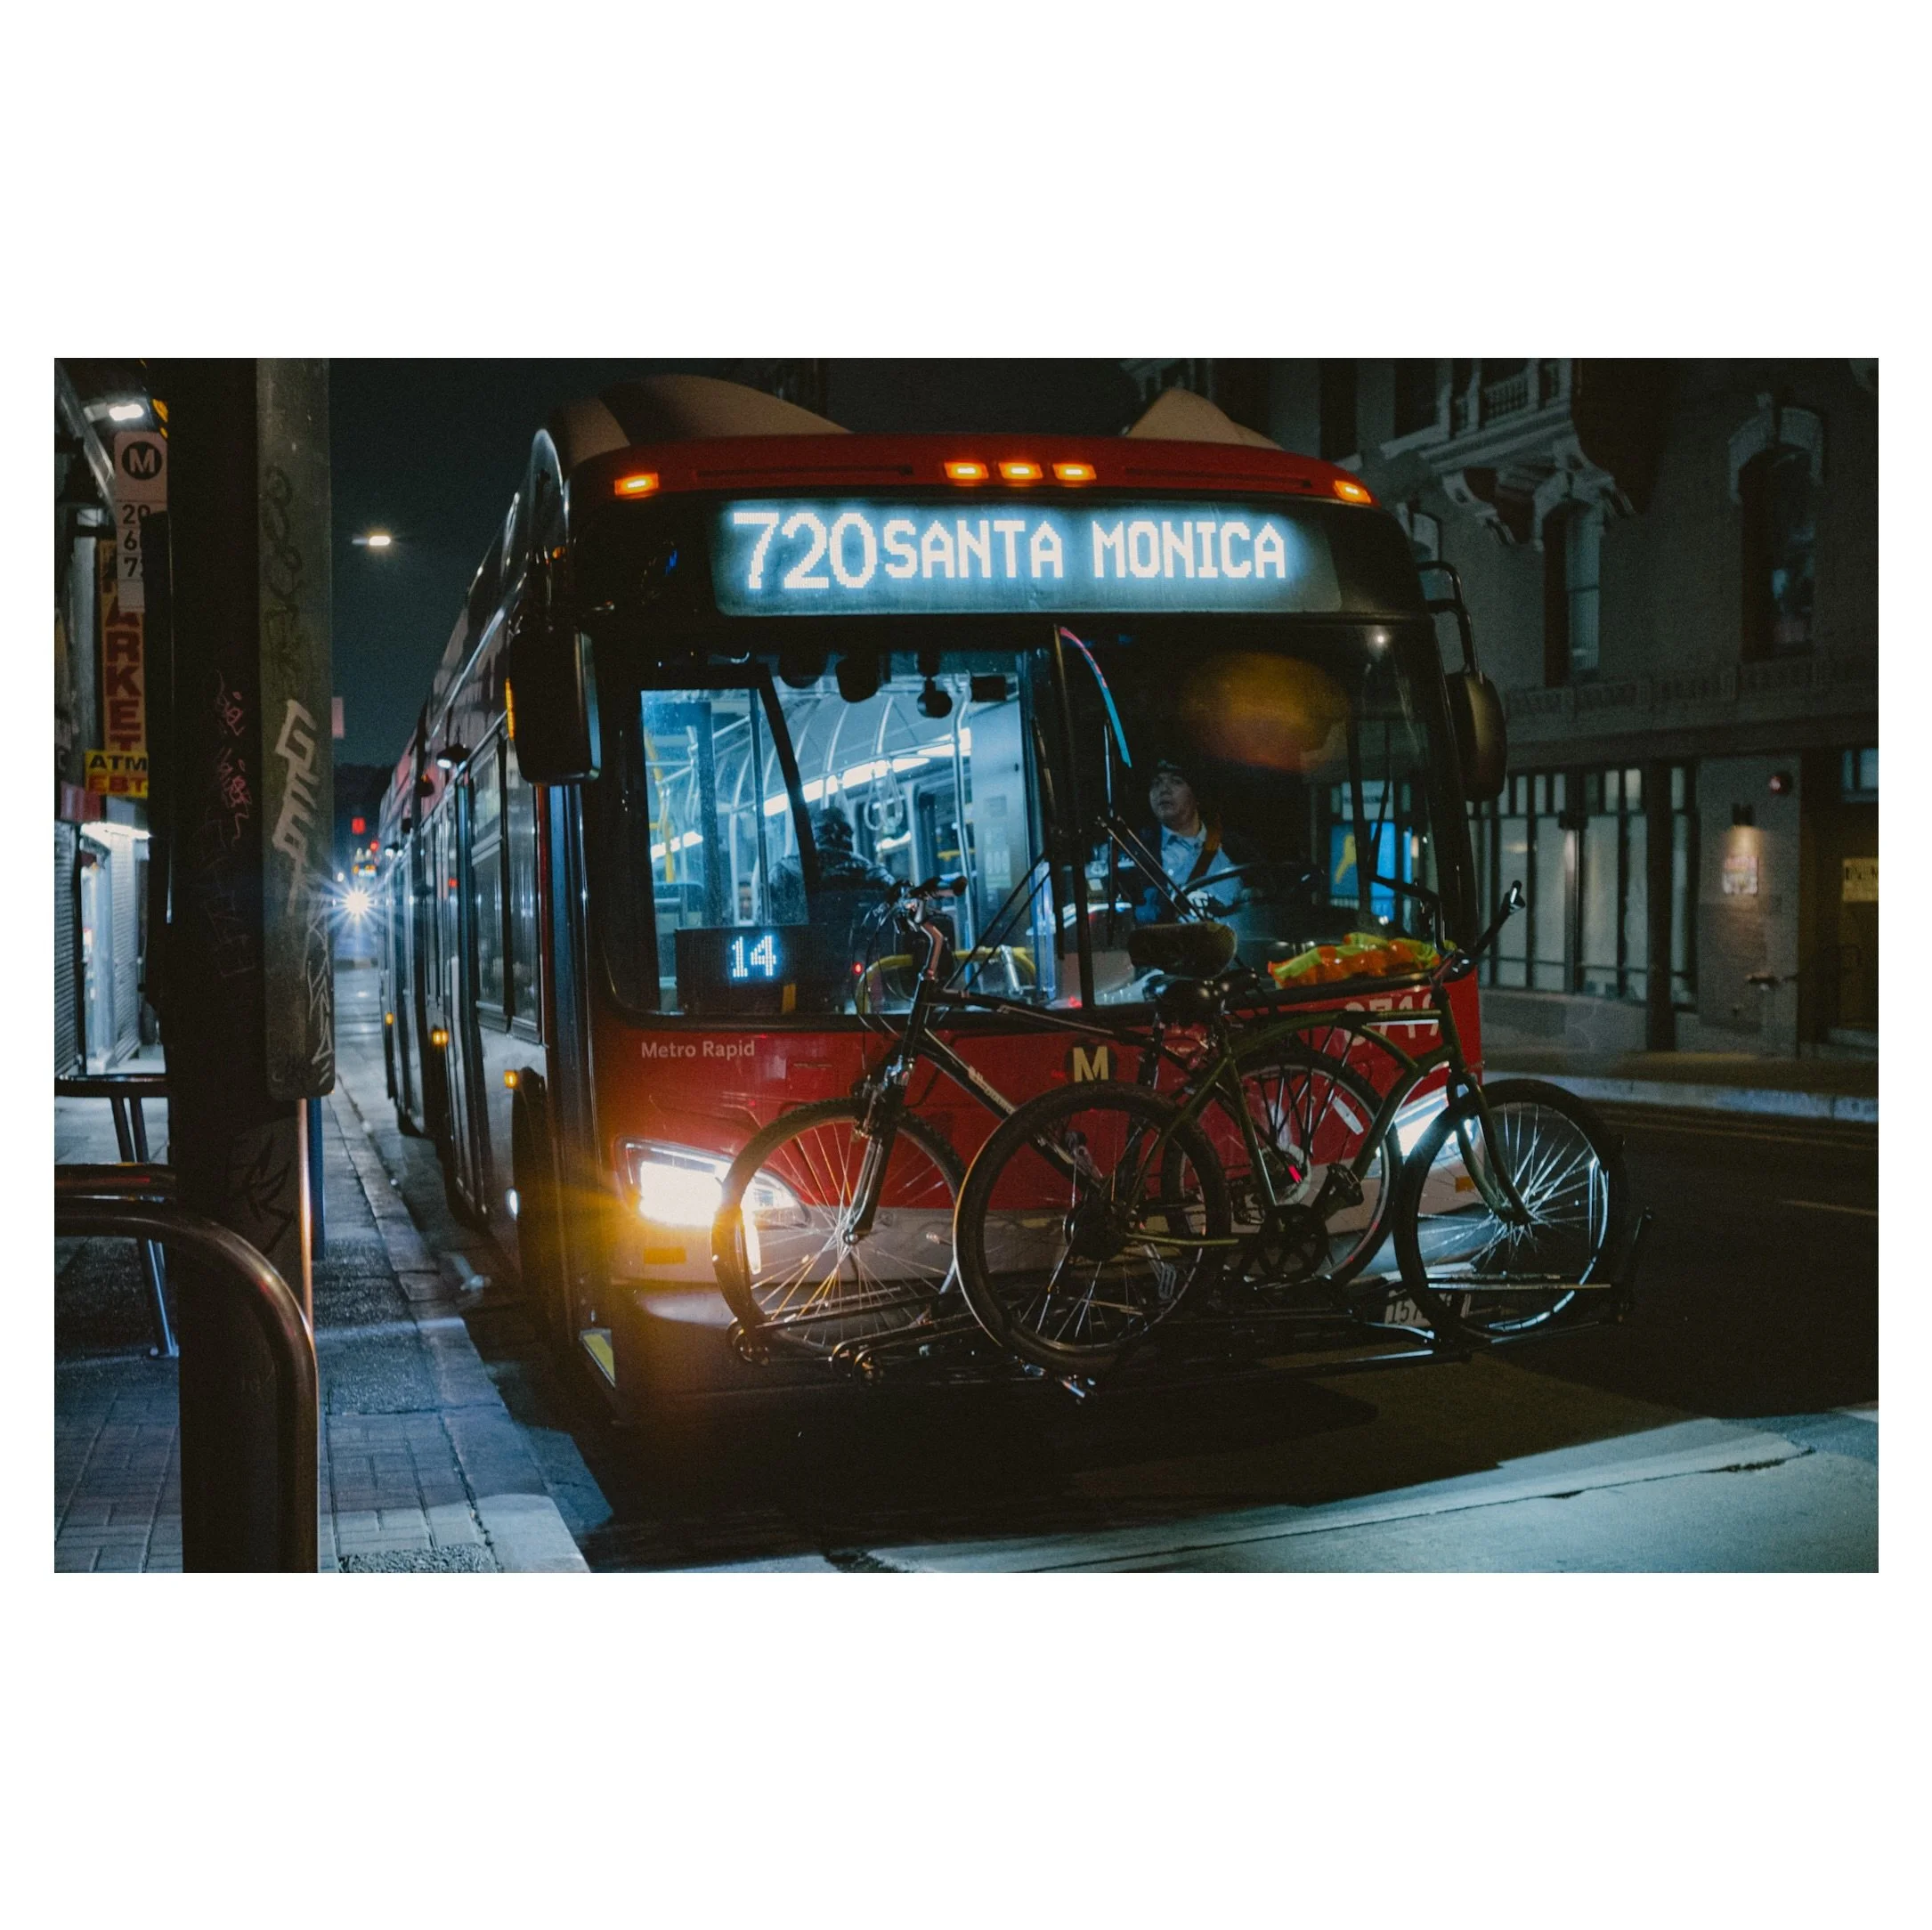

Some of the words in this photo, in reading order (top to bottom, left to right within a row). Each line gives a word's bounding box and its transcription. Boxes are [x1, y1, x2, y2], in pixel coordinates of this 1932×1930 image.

[128, 448, 156, 474] M
[124, 531, 142, 550] 6
[734, 513, 877, 588] 720
[883, 520, 1063, 578] SANTA
[1092, 521, 1286, 579] MONICA
[124, 557, 142, 578] 7
[104, 563, 142, 751] ARKET
[89, 755, 148, 771] ATM
[88, 775, 148, 793] EBT
[730, 936, 776, 977] 14
[641, 1042, 696, 1058] Metro
[702, 1041, 755, 1061] Rapid
[1073, 1046, 1109, 1083] M
